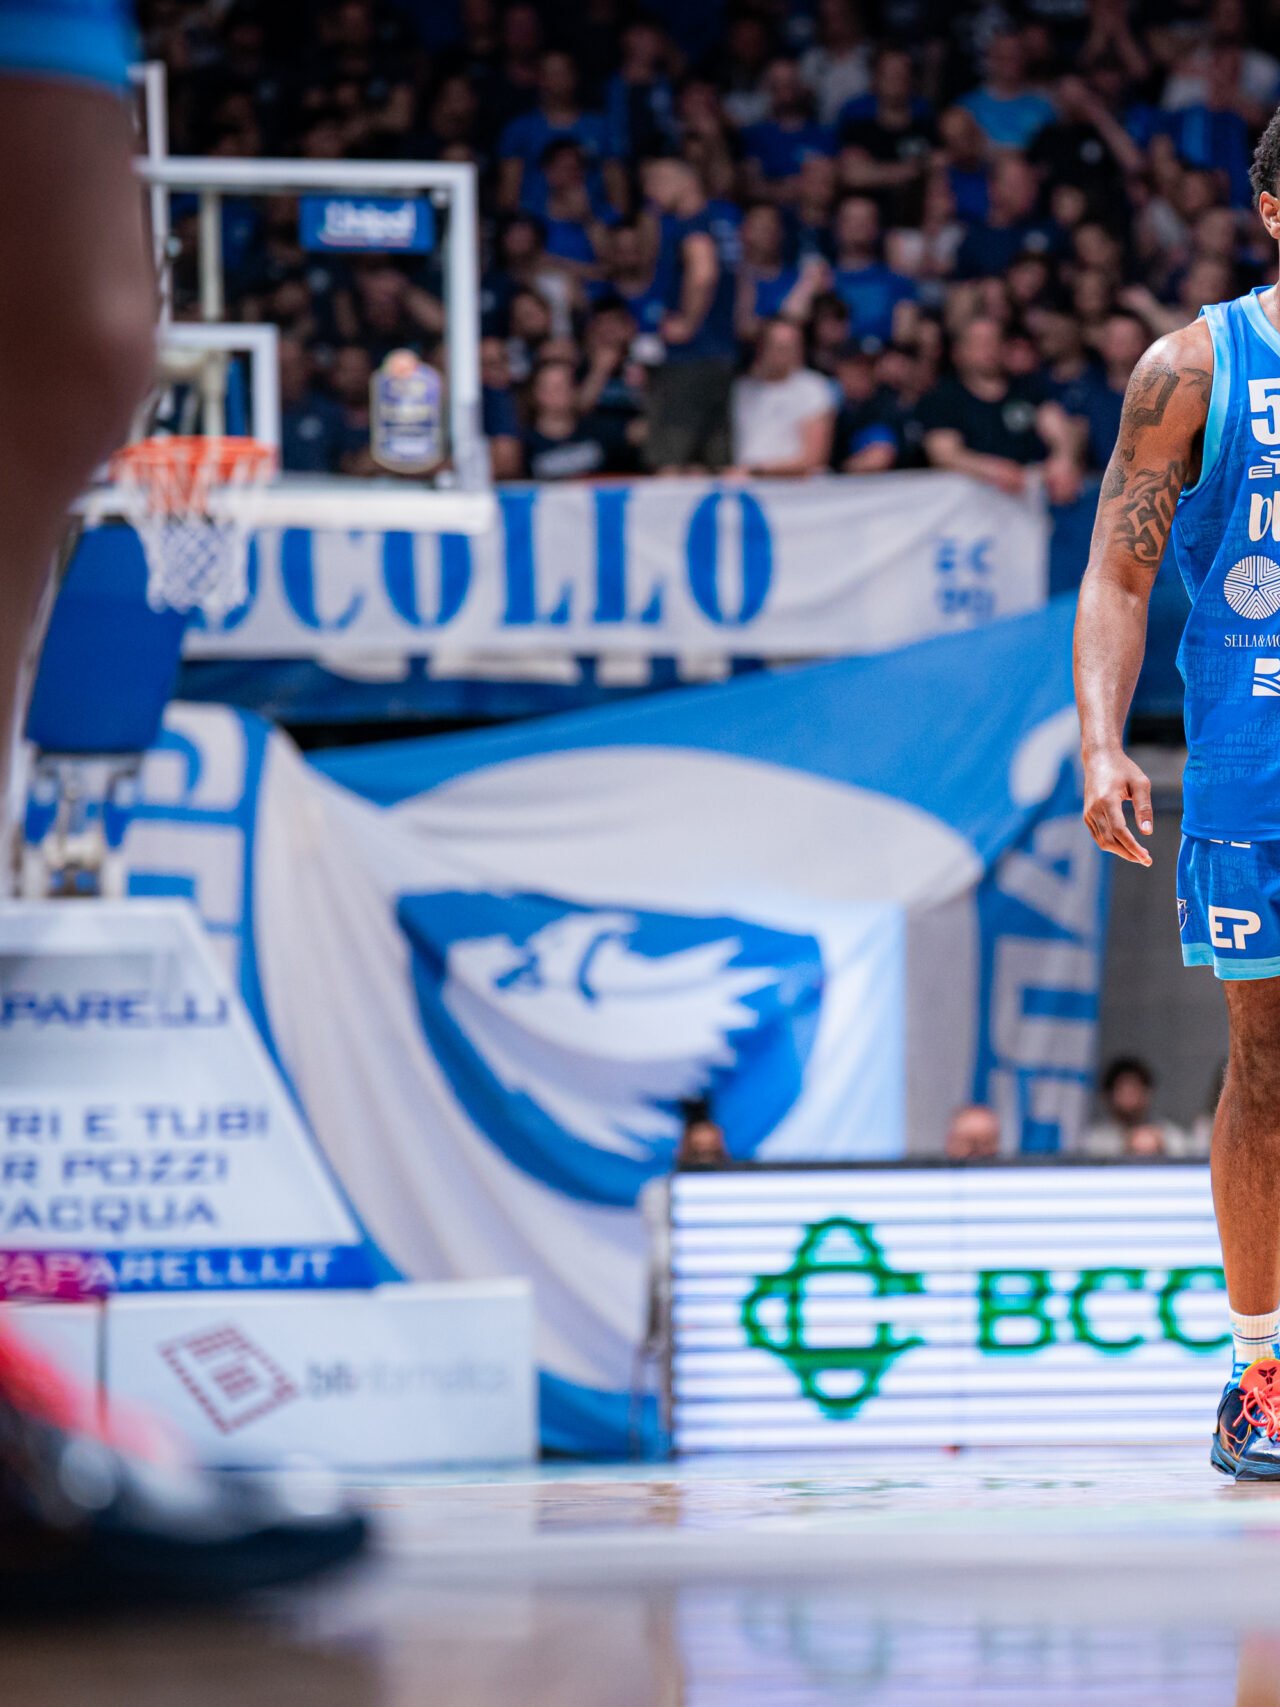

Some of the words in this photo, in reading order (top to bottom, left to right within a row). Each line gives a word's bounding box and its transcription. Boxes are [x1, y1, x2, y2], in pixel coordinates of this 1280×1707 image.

[1, 1106, 61, 1143] RI
[84, 1106, 119, 1142] E
[139, 1105, 269, 1142] TUBI
[62, 1151, 229, 1187] POZZI
[978, 1267, 1232, 1352] BCC
